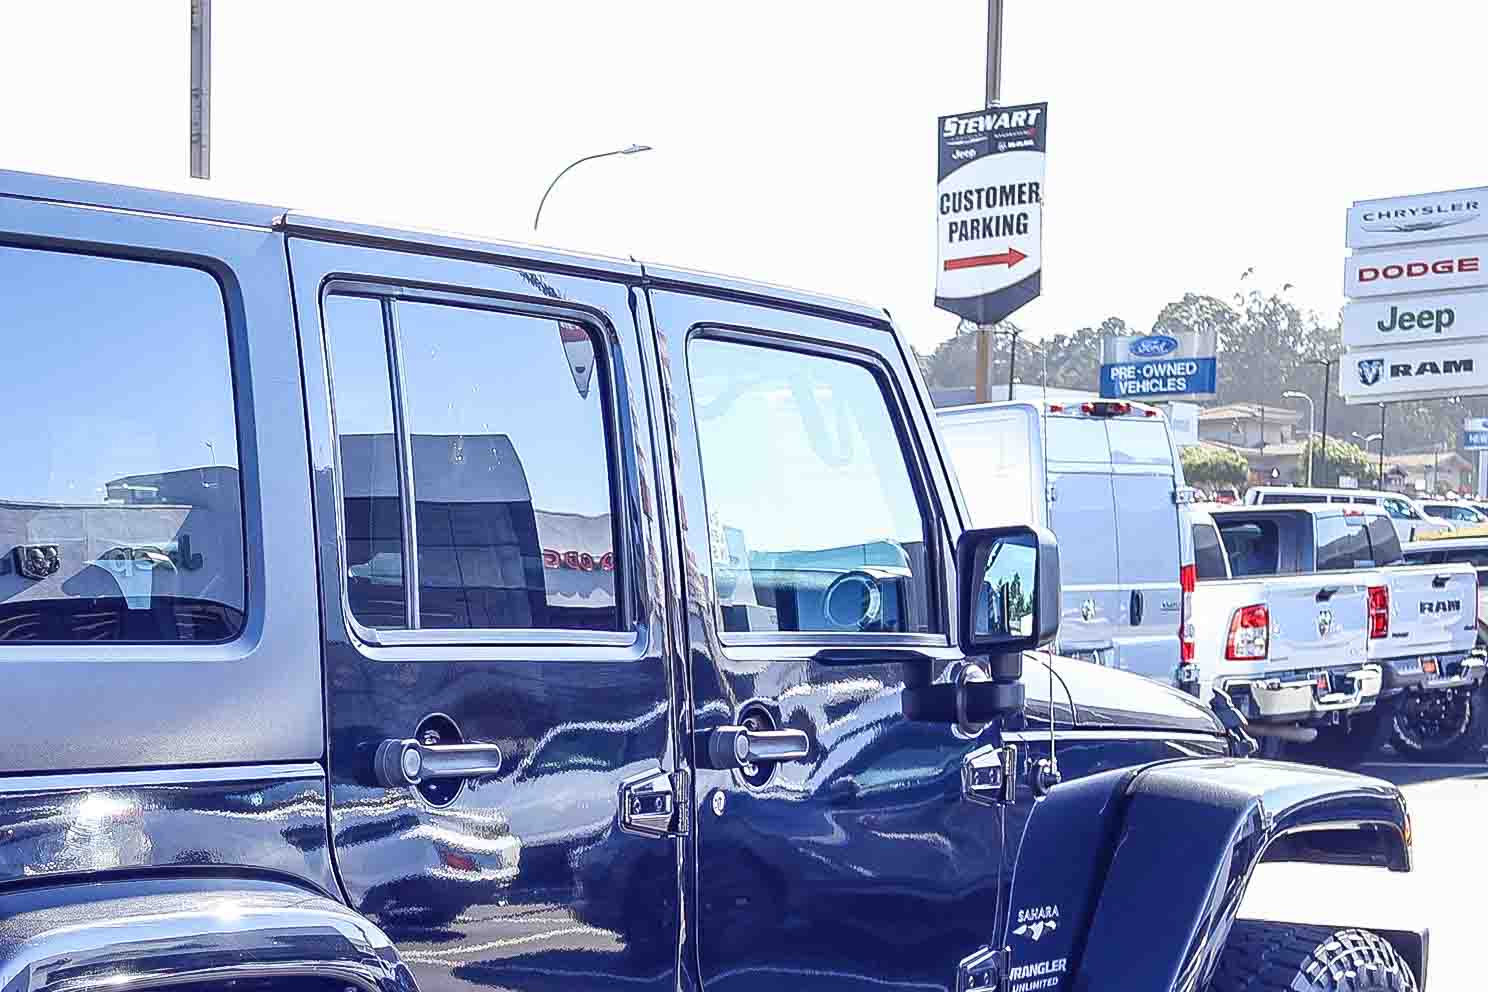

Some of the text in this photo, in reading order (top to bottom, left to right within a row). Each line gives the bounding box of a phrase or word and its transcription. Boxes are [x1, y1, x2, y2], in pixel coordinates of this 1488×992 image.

[943, 109, 1041, 137] STEWART
[940, 181, 1041, 215] CUSTOMER
[1362, 201, 1480, 221] CHRYSLER
[948, 212, 1029, 243] PARKING
[1358, 257, 1480, 282] DODGE
[1377, 306, 1455, 333] Jeep
[1110, 361, 1198, 380] PRE-OWNED
[1390, 359, 1474, 377] RAM
[1119, 377, 1187, 394] VEHICLES
[1419, 600, 1461, 613] RAM
[1017, 905, 1059, 923] SAHARA
